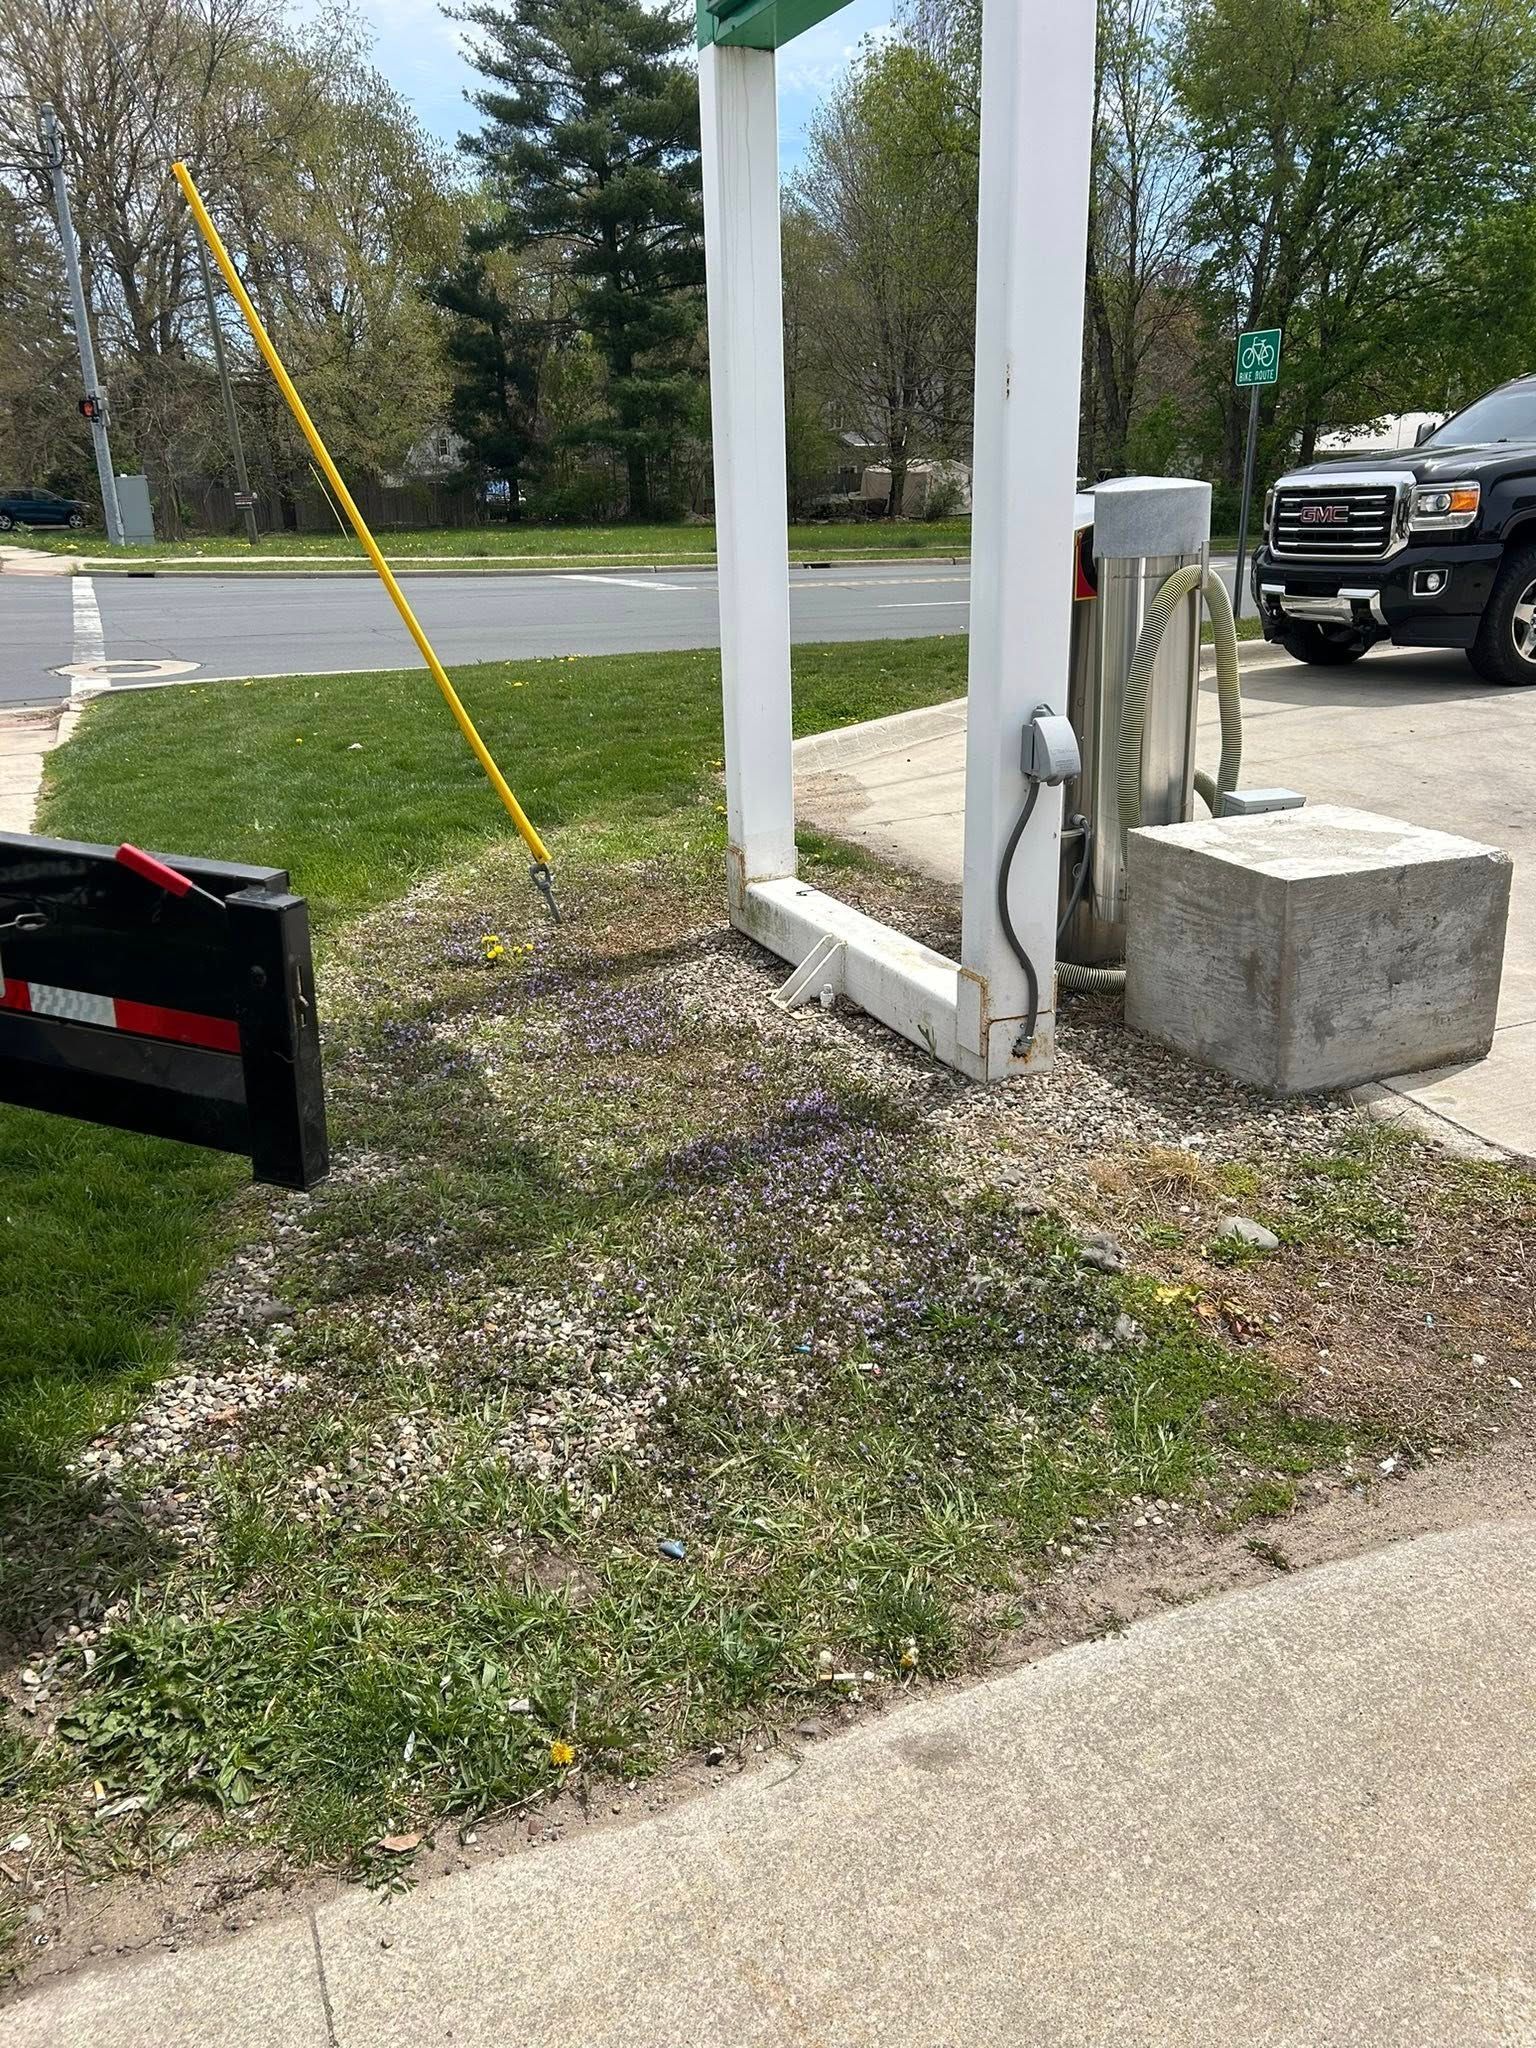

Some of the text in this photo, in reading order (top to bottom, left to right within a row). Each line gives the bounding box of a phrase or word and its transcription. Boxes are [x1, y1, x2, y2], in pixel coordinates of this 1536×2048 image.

[1239, 369, 1274, 382] BIKE ROUTE
[1300, 505, 1349, 523] GMC
